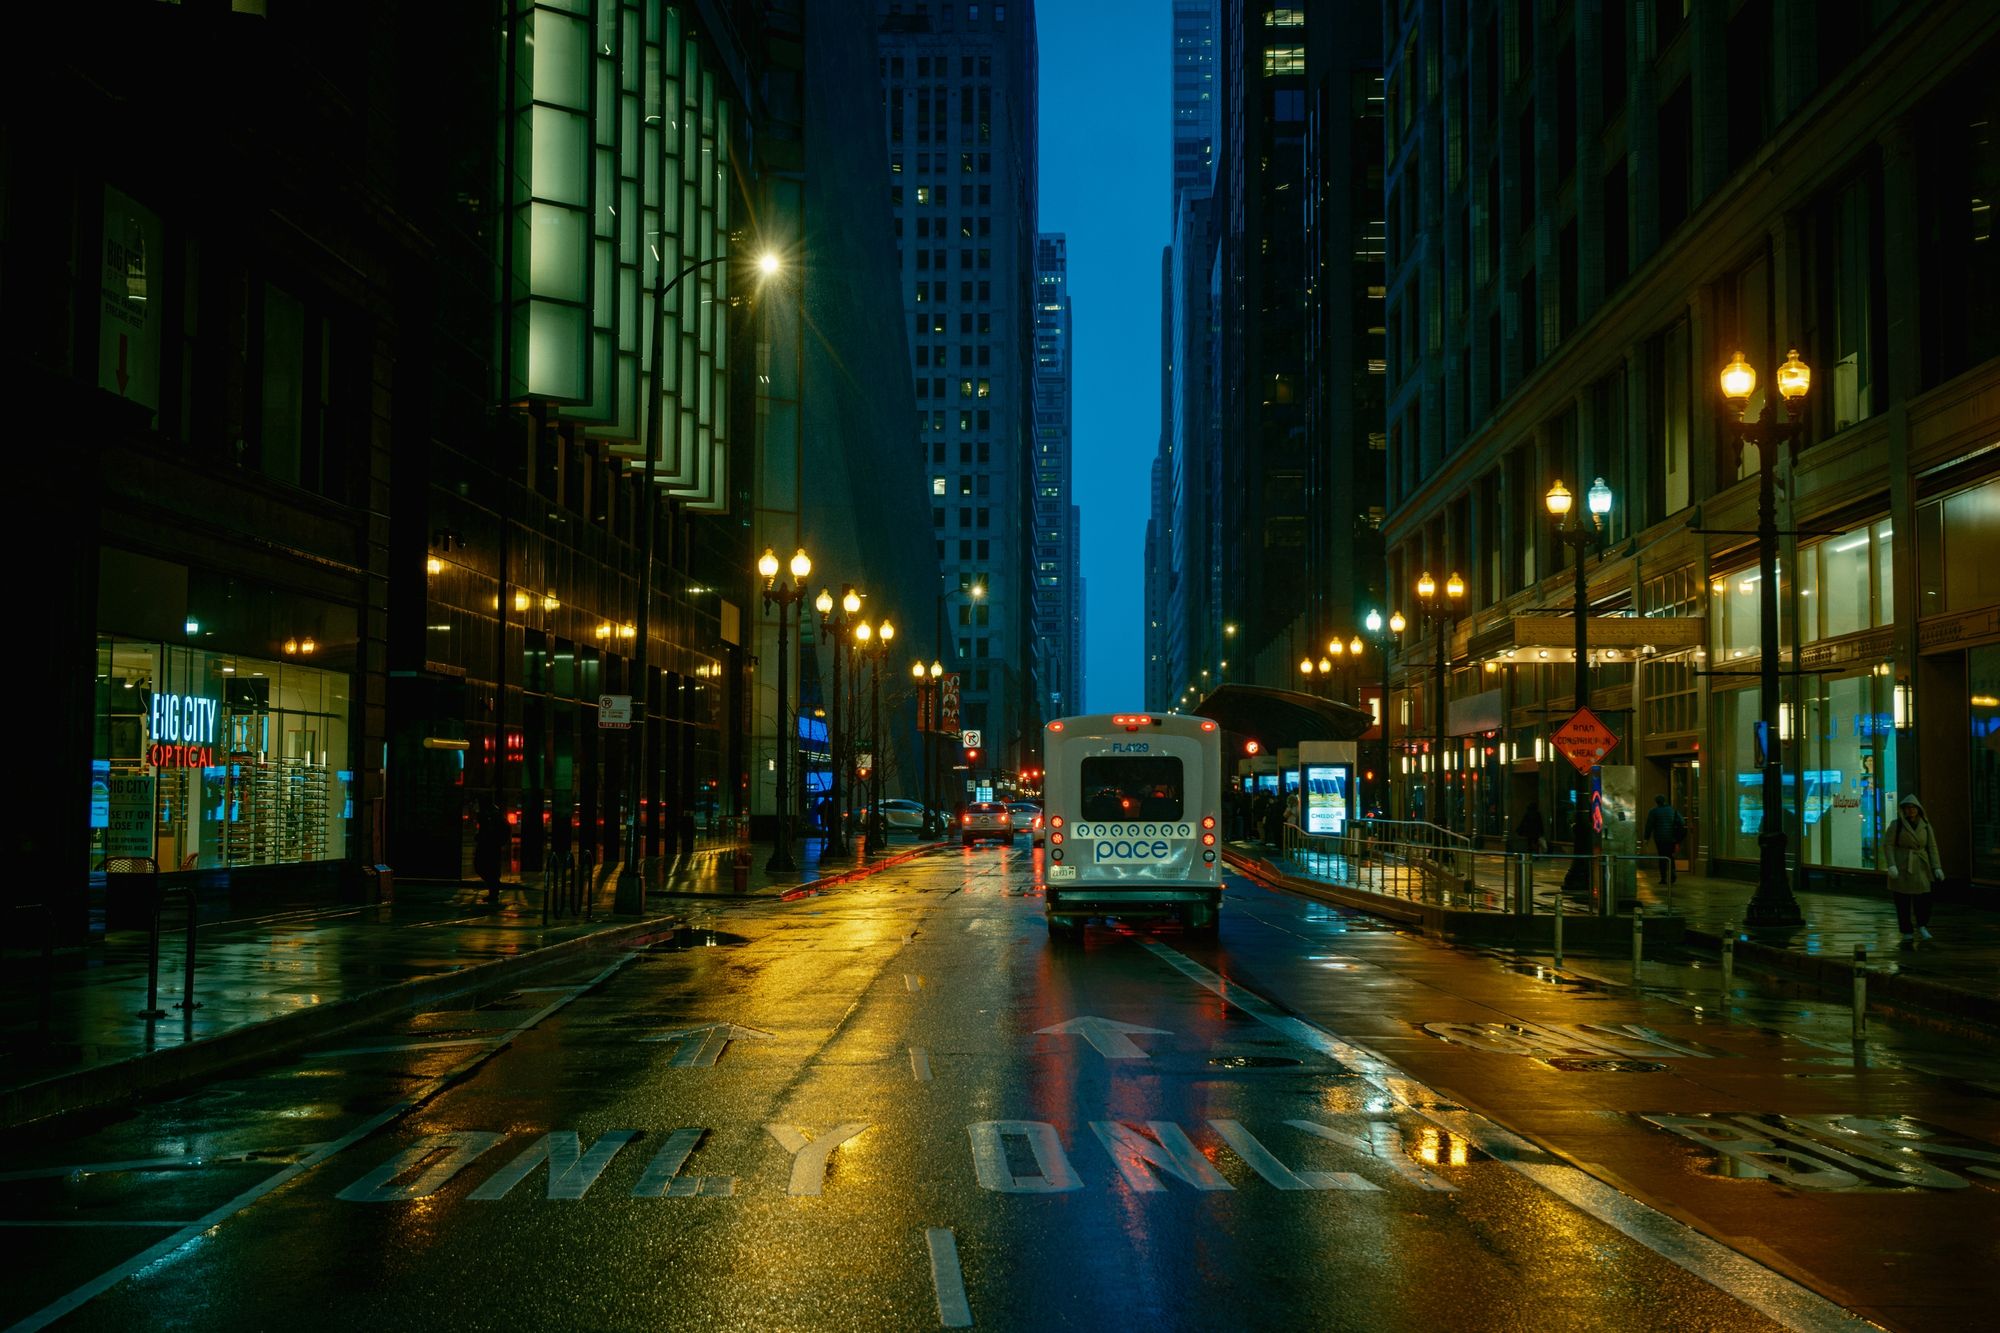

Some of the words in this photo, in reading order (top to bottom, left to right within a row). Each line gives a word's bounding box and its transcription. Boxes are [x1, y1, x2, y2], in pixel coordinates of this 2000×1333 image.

[107, 238, 122, 271] BIG
[152, 693, 179, 741] BIG
[184, 695, 216, 743] CITY
[152, 744, 215, 769] OPTICAL
[1112, 743, 1149, 753] FL4129
[126, 779, 150, 794] CITY
[110, 810, 121, 819] SE
[1096, 841, 1169, 863] pace
[334, 1120, 873, 1201] ONLY
[966, 1118, 1462, 1193] ONLY
